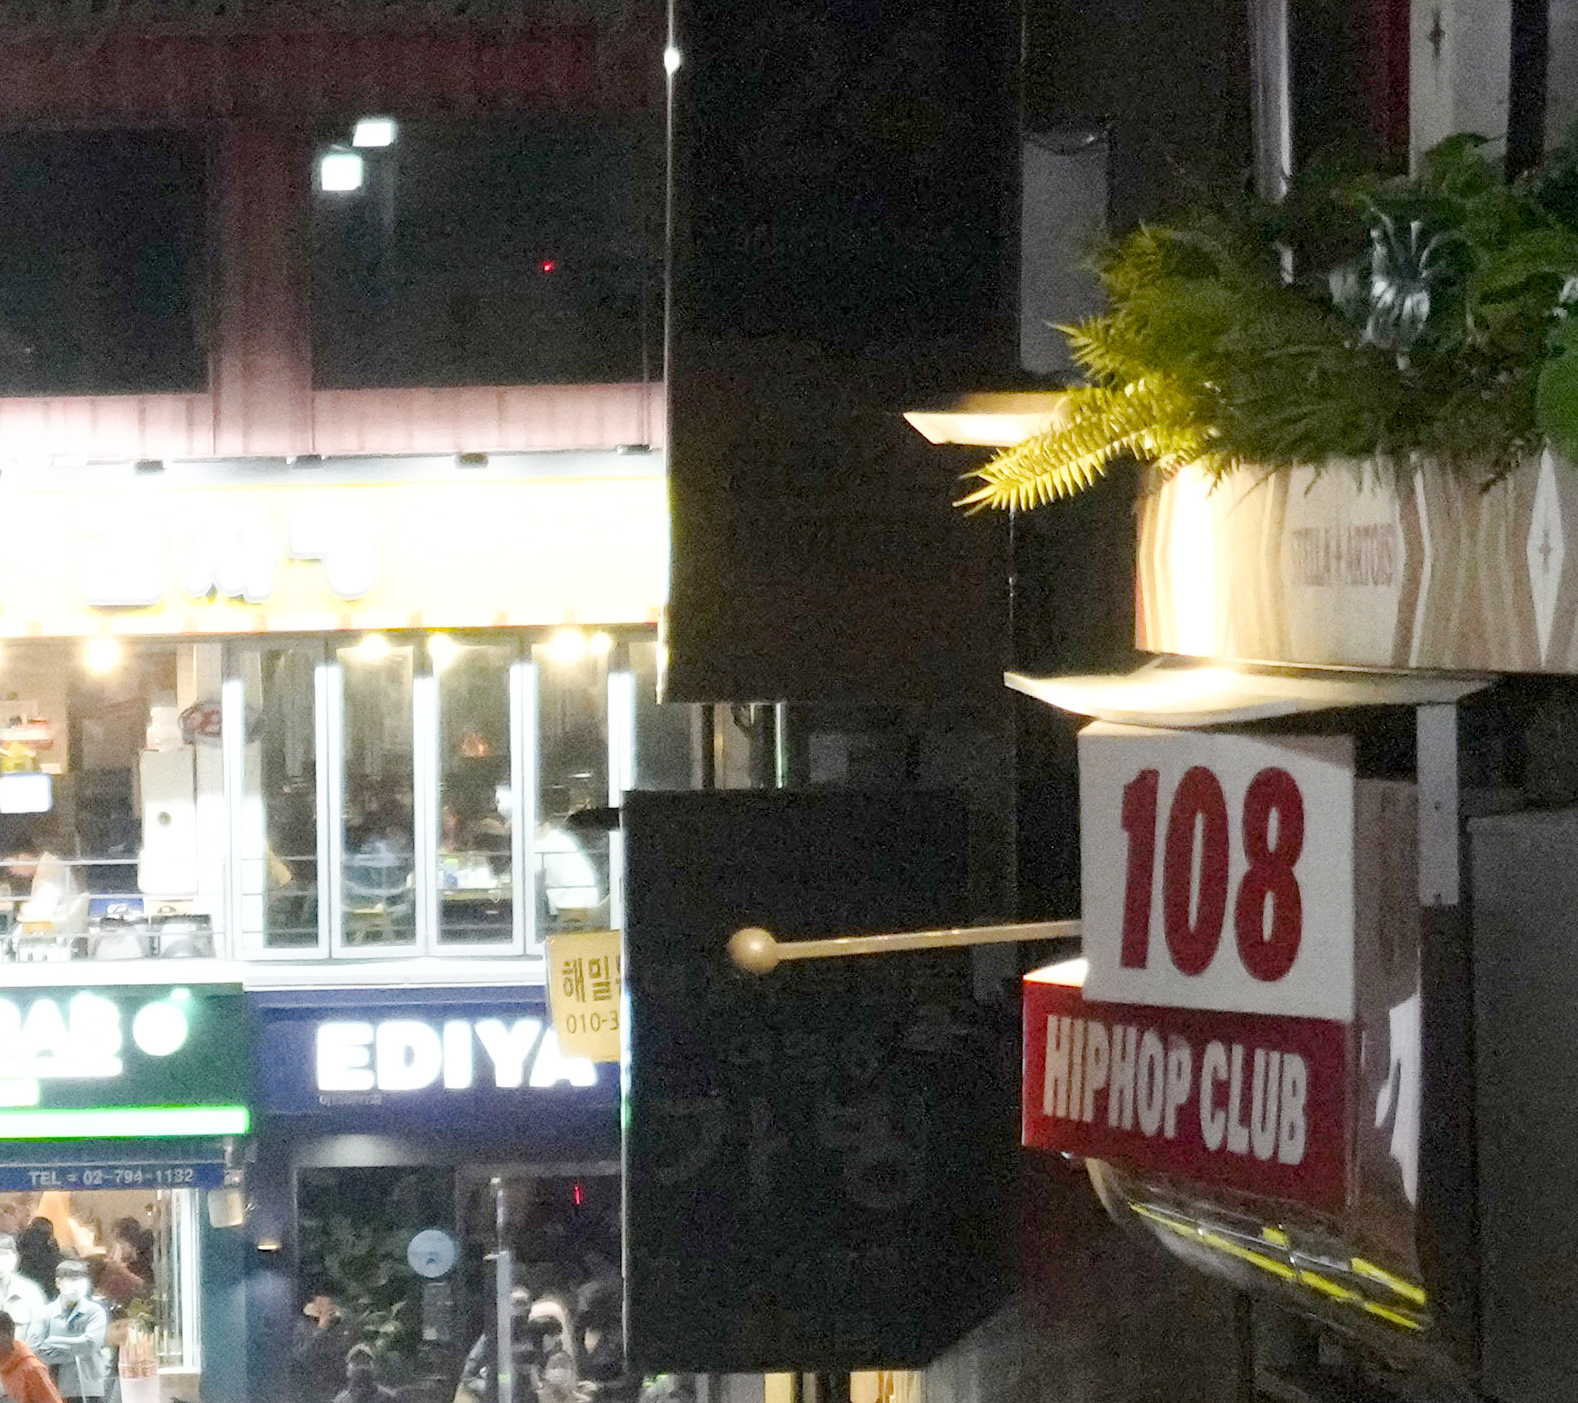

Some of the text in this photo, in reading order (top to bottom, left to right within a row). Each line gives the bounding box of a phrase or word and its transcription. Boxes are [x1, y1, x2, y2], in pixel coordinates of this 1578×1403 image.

[1119, 765, 1305, 982] 108
[316, 1018, 597, 1092] EDIYA
[1043, 1012, 1308, 1167] HIPHOP CLUB
[28, 1170, 62, 1187] TEL
